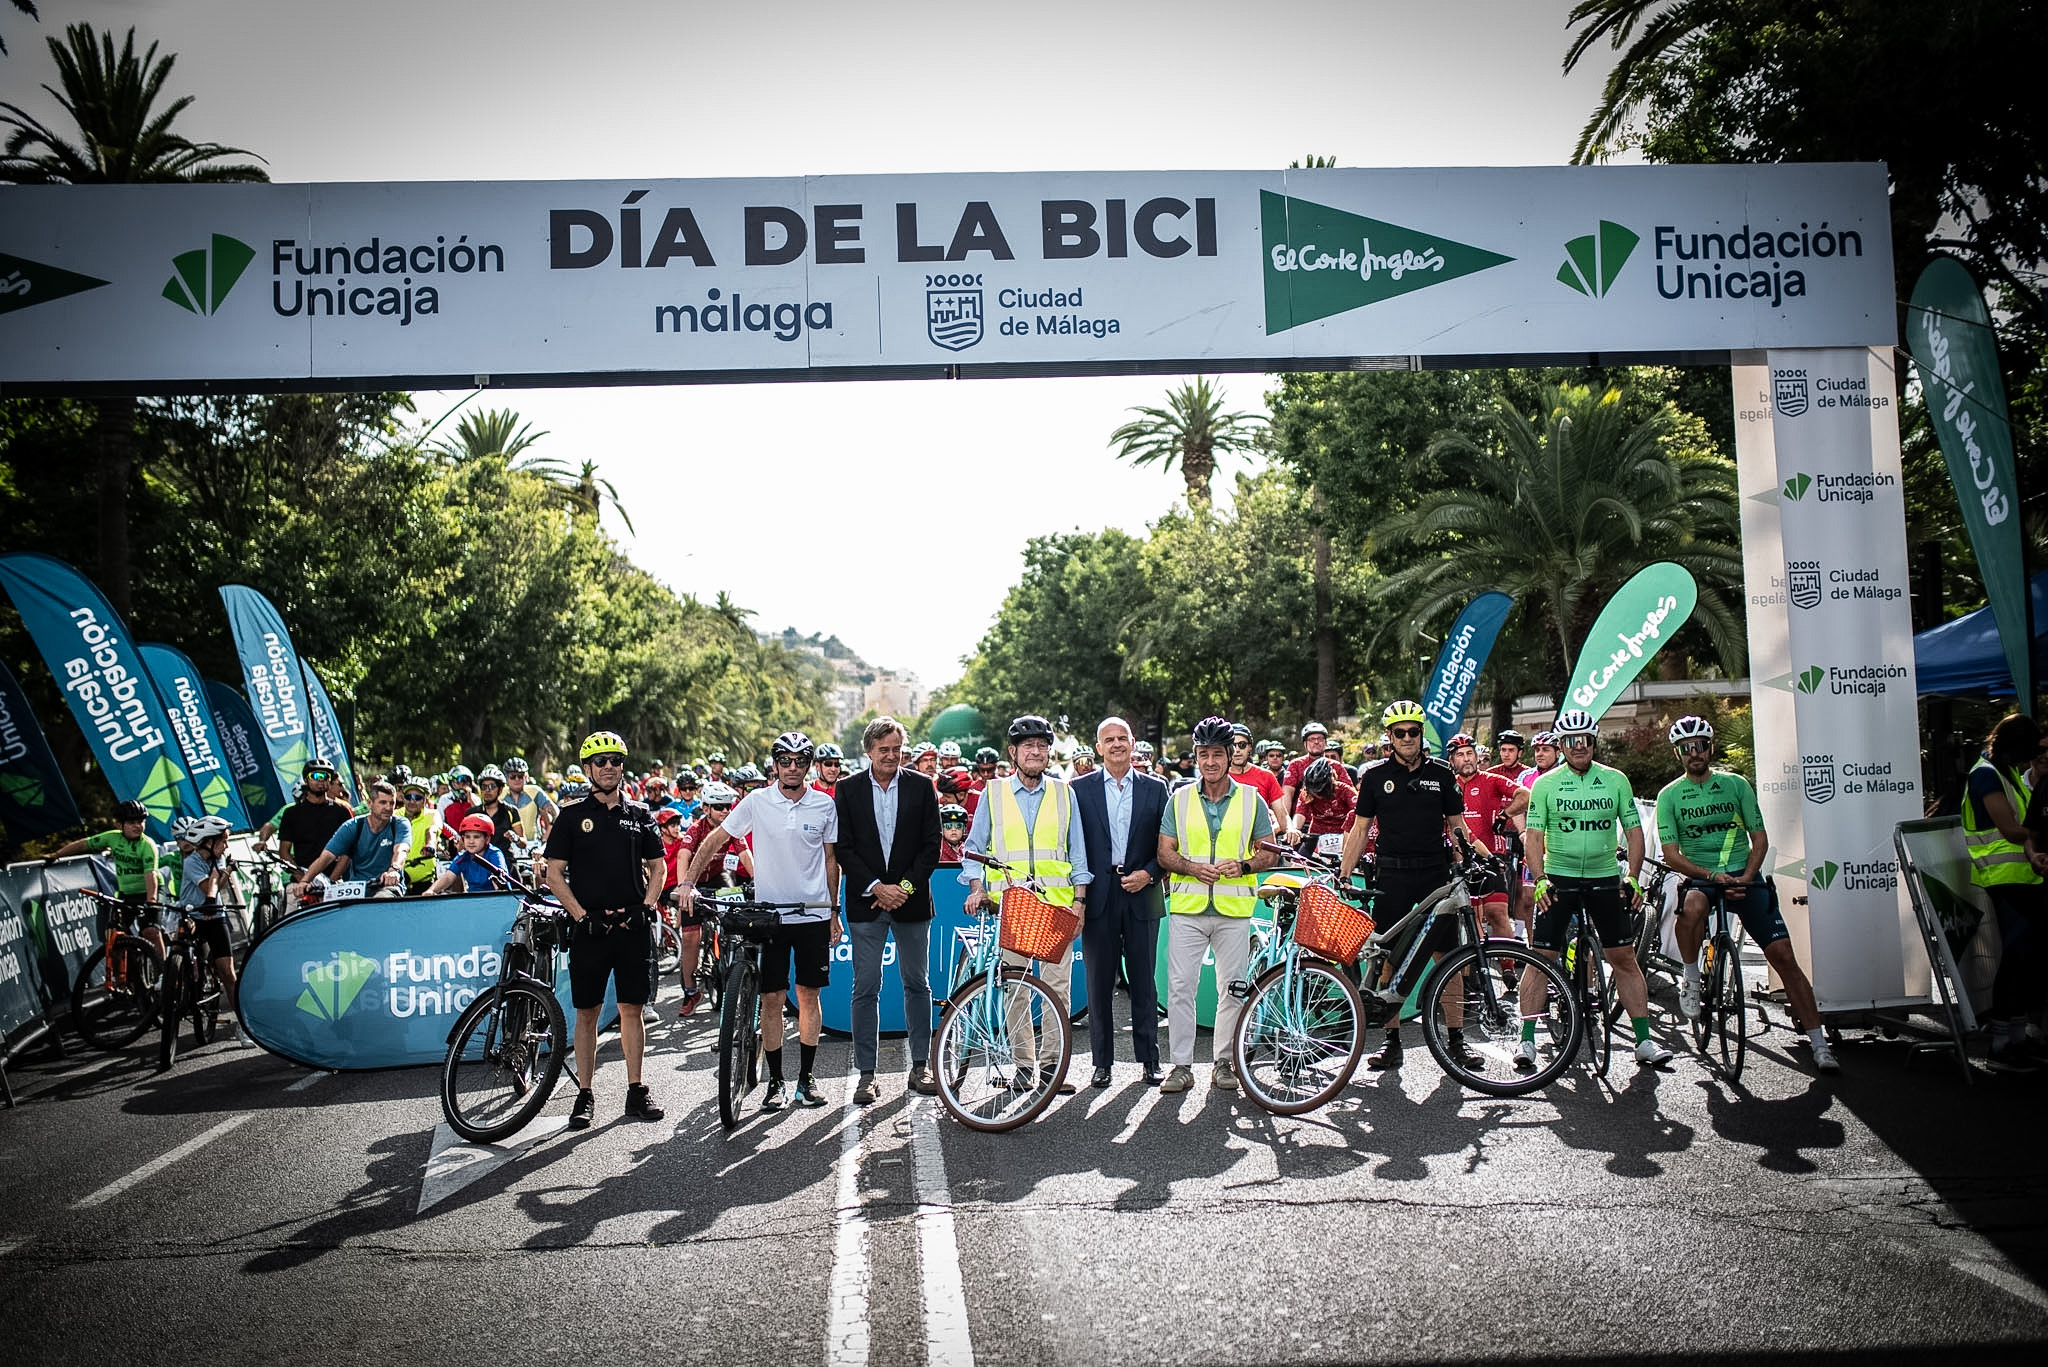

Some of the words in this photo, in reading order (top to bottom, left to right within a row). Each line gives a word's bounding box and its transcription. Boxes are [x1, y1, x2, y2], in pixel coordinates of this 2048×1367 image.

[549, 190, 716, 269] DÍA
[744, 204, 866, 265] DE
[896, 201, 1015, 262] LA
[1041, 197, 1218, 260] BICI
[1655, 222, 1863, 261] Fundación
[272, 235, 505, 276] Fundación
[1271, 244, 1298, 271] El
[1299, 244, 1358, 271] Corte
[1360, 237, 1445, 281] Inglés
[1655, 262, 1807, 308] Unicaja
[272, 278, 440, 326] Unicaja
[998, 288, 1083, 309] Ciudad
[999, 316, 1031, 337] de
[1035, 313, 1121, 341] Málaga
[1816, 378, 1866, 391] Ciudad
[1817, 396, 1836, 408] de
[1840, 394, 1889, 410] Málaga
[1817, 473, 1894, 488] Fundación
[1817, 488, 1874, 504] Unicaja
[1829, 569, 1879, 582] Ciudad
[1830, 587, 1850, 600] de
[1853, 585, 1902, 602] Málaga
[1427, 624, 1476, 717] Fundación
[1589, 648, 1631, 690] Corte
[1830, 664, 1907, 681] Fundación
[1440, 658, 1478, 724] Unicaja
[1830, 681, 1886, 697] Unicaja
[1842, 762, 1891, 776] Ciudad
[1843, 780, 1863, 794] de
[1866, 779, 1915, 794] Málaga
[1556, 798, 1613, 811] PROLONGO
[1680, 802, 1735, 821] PROLONGO
[1843, 858, 1902, 876] Fundaci
[337, 888, 361, 897] 590
[1844, 875, 1898, 892] Unicaja
[389, 945, 501, 984] Funda
[389, 982, 490, 1018] Unic
